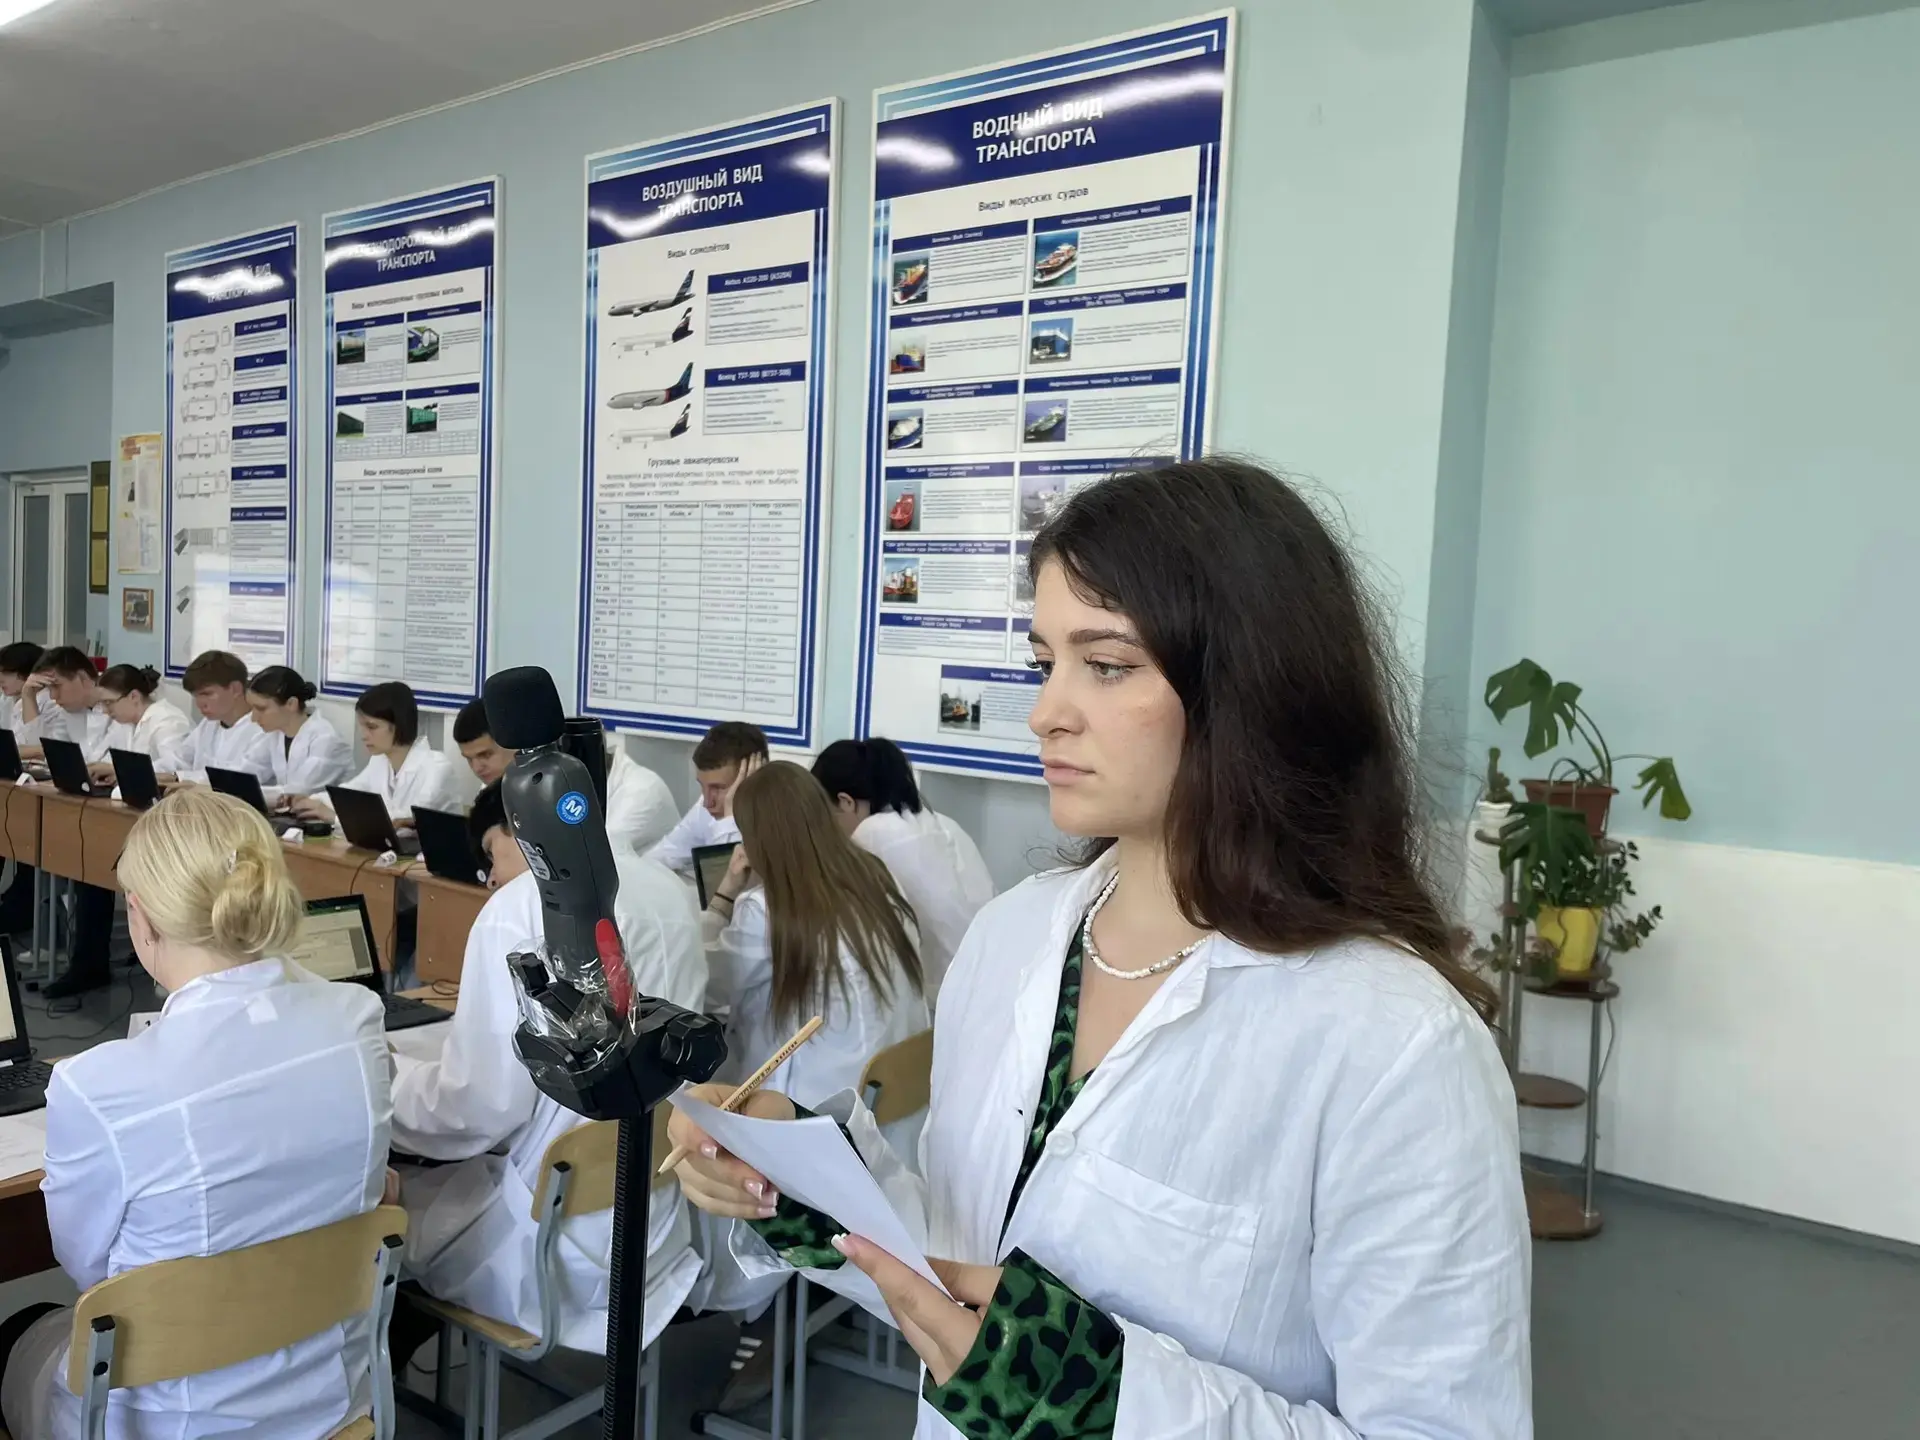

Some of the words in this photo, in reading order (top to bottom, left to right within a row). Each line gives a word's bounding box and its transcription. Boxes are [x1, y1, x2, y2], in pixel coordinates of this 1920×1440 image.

[972, 102, 1054, 139] ВОДНЫЙ
[1062, 96, 1104, 122] ВИД
[976, 126, 1096, 164] ТРАНСПОРТА
[642, 167, 728, 202] ВОЗДУШНЫЙ
[733, 163, 763, 184] ВИД
[657, 191, 744, 218] ТРАНСПОРТА
[978, 200, 1006, 212] Виды
[1009, 193, 1052, 207] морских
[1057, 188, 1089, 201] судов
[376, 250, 436, 273] ТРАНСПОРТА
[667, 249, 687, 259] Виды
[648, 458, 680, 468] Грузовые
[683, 456, 739, 466] авиаперевозки
[565, 799, 583, 817] M
